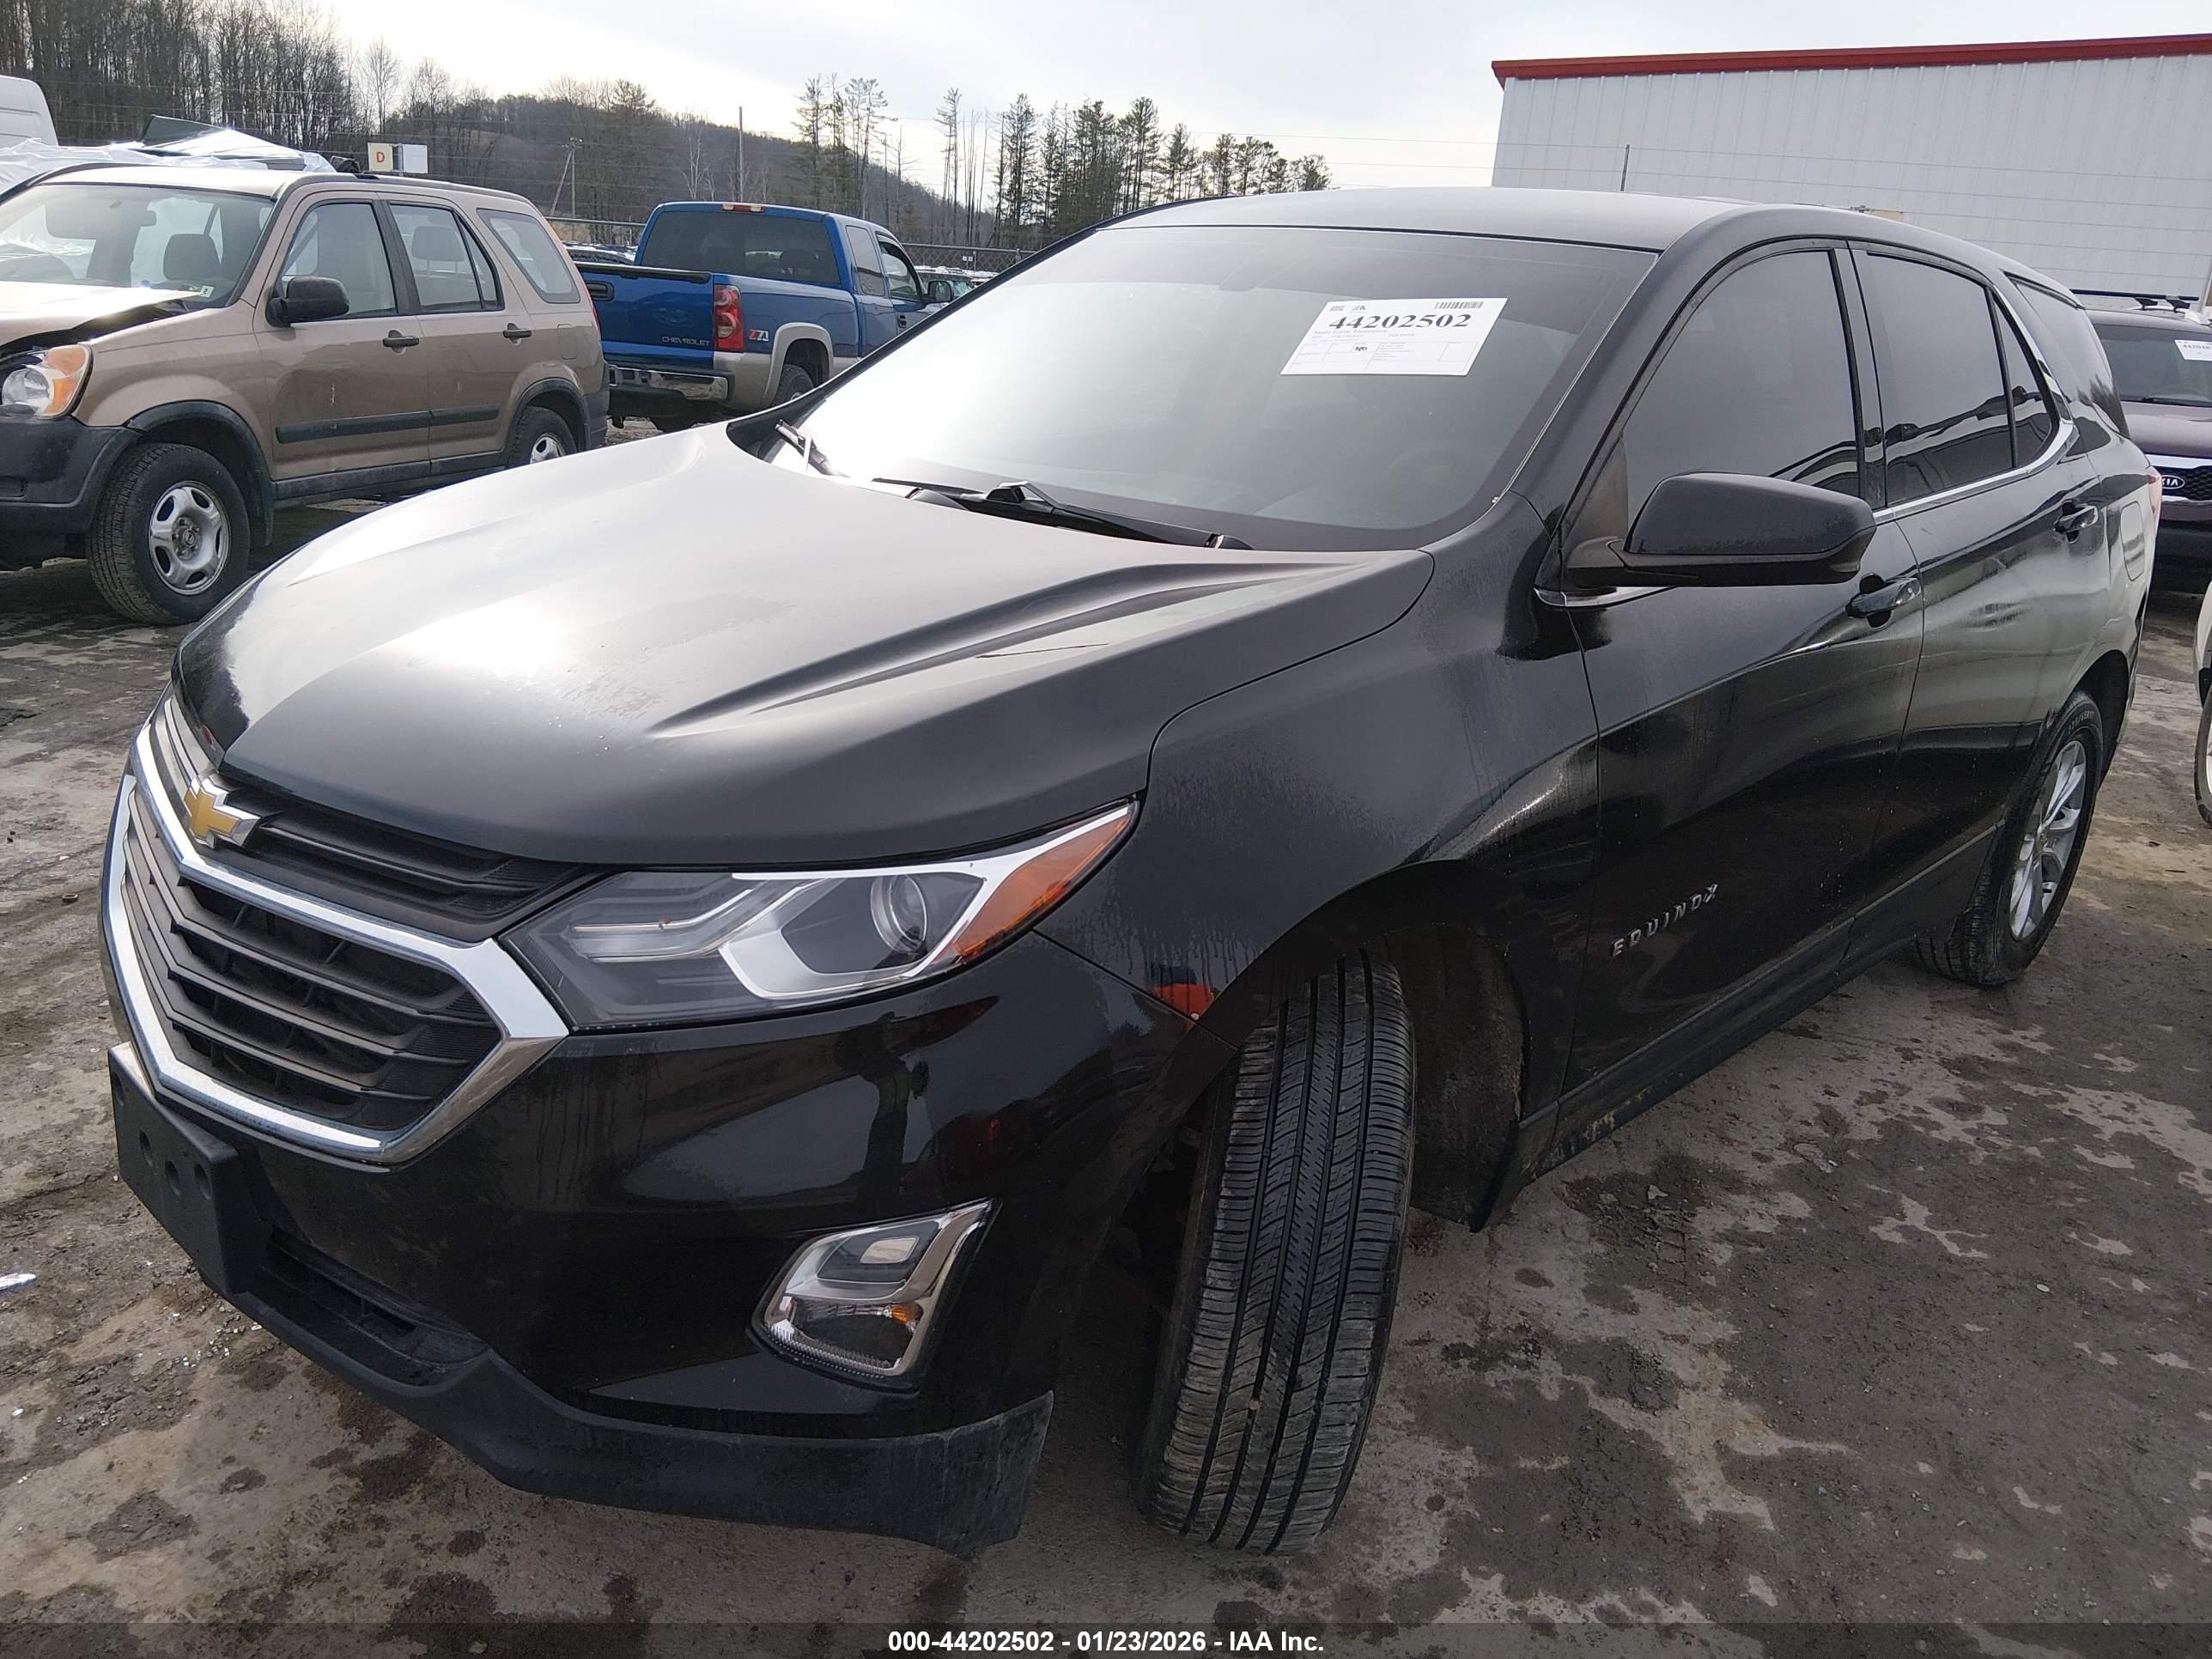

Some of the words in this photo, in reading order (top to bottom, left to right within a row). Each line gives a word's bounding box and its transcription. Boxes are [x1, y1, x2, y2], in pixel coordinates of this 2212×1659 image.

[376, 151, 386, 163] D
[1328, 314, 1472, 329] 44202502
[661, 336, 710, 346] CHEVROLET
[748, 329, 769, 342] Z71
[1611, 883, 1717, 957] EQUINOX
